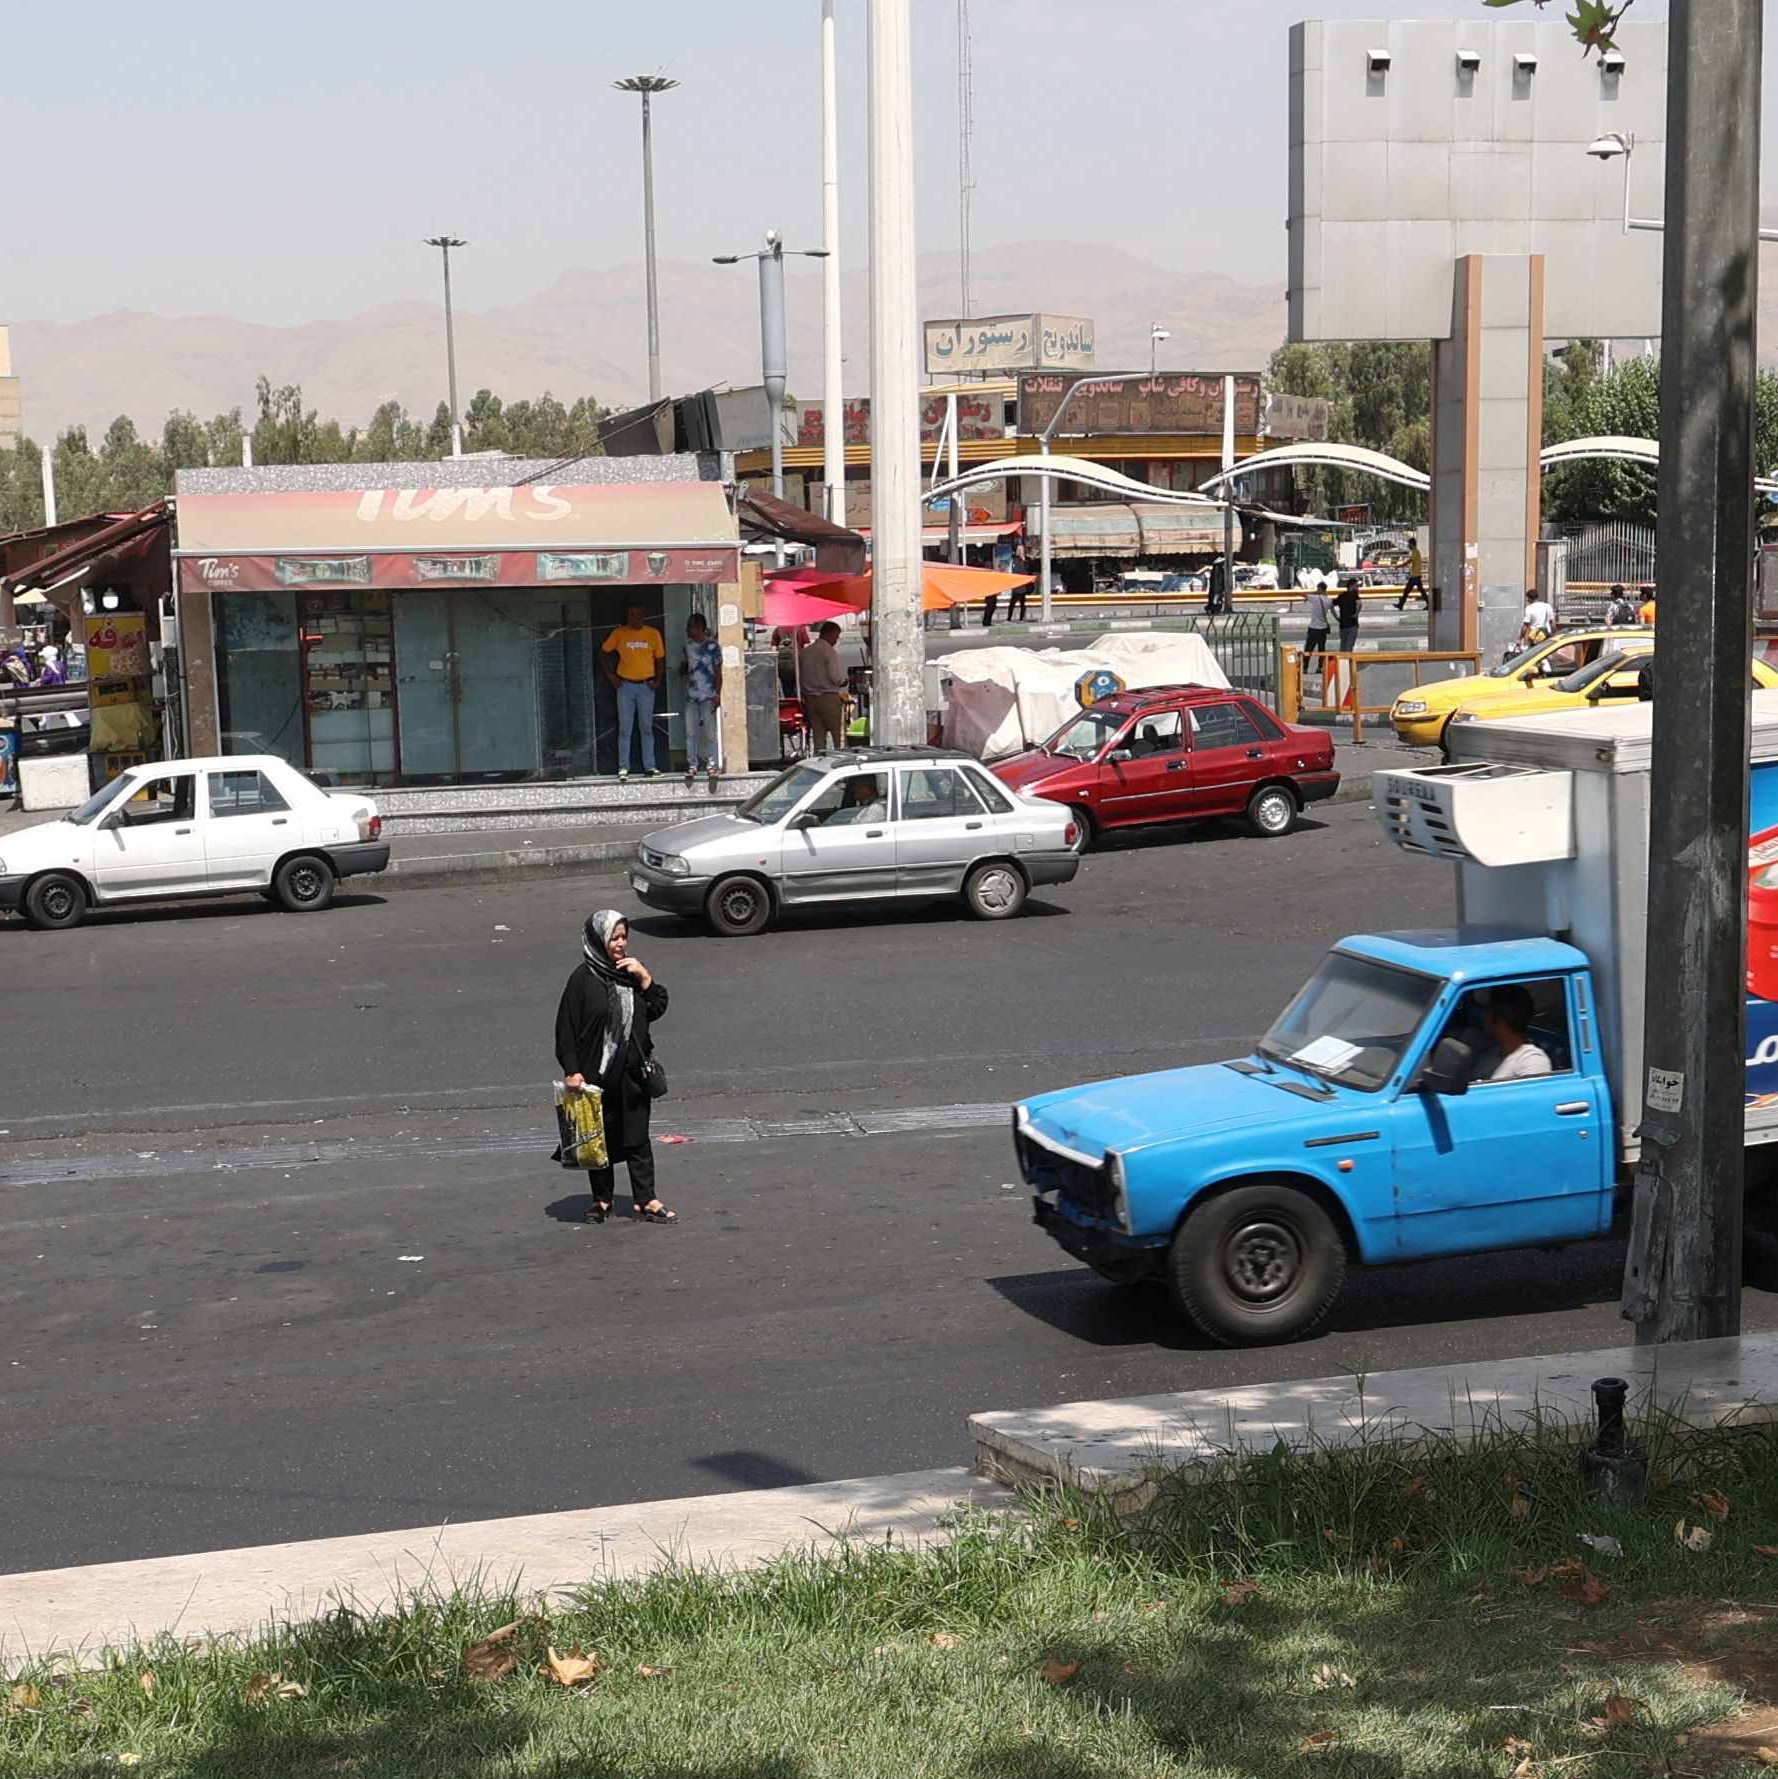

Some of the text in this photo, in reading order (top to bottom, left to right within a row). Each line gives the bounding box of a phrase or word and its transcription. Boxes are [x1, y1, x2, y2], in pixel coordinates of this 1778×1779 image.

[935, 321, 1029, 358] رستوران
[1043, 322, 1094, 360] ساندویچ
[1024, 377, 1064, 394] تنقلات
[1138, 377, 1165, 398] شاپ
[197, 558, 240, 579] Tim's
